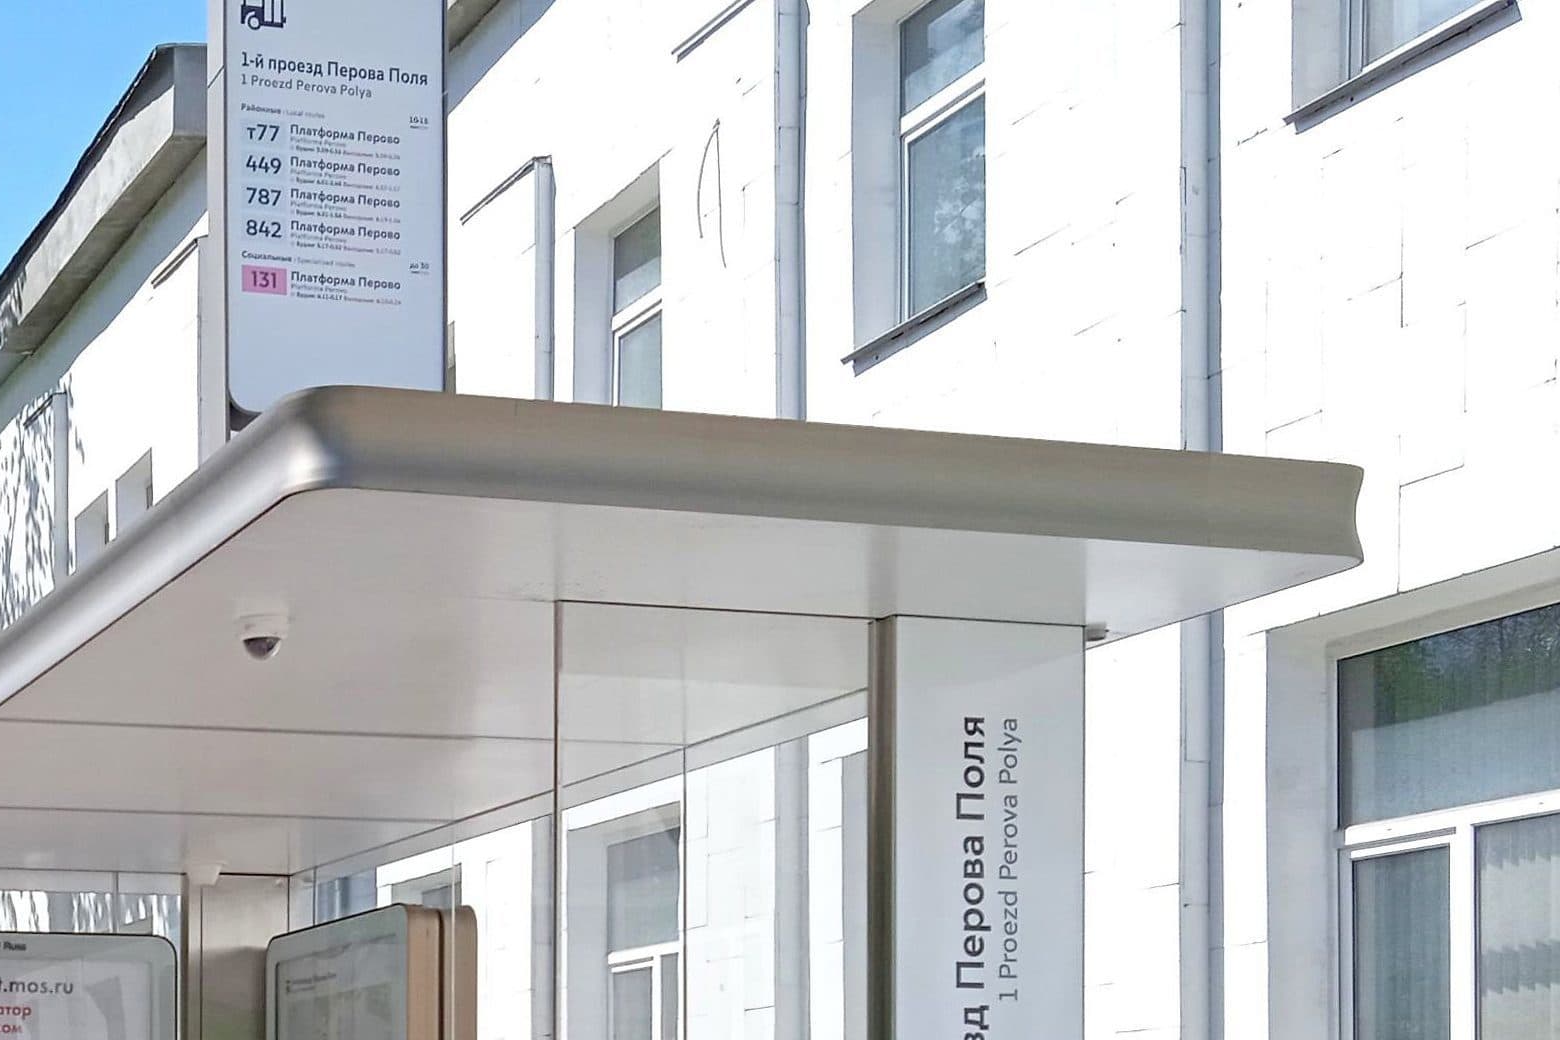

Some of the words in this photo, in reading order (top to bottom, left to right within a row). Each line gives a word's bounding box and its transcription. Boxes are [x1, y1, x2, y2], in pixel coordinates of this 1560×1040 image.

[242, 52, 264, 69] 1-й
[268, 59, 324, 78] проезд
[327, 61, 384, 81] Перова
[389, 67, 428, 86] Поля
[241, 74, 247, 84] 1
[251, 75, 293, 89] Proezd
[297, 80, 336, 94] Perova
[340, 84, 372, 99] Polya
[247, 124, 280, 142] т77
[290, 124, 355, 140] Платформа
[358, 130, 400, 144] Перово
[246, 155, 282, 174] 449
[290, 156, 355, 172] Платформа
[358, 162, 400, 176] Перово
[246, 187, 282, 206] 787
[290, 188, 355, 204] Платформа
[358, 194, 400, 208] Перово
[246, 219, 282, 238] 842
[290, 220, 355, 236] Платформа
[358, 226, 400, 240] Перово
[251, 271, 278, 289] 131
[291, 271, 355, 287] Платформа
[358, 276, 401, 290] Перово
[997, 718, 1022, 784] Polya
[955, 717, 985, 820] Поля
[998, 795, 1018, 880] Perova
[955, 835, 991, 989] Перова
[997, 891, 1018, 979] Proezd
[999, 989, 1018, 1001] 1
